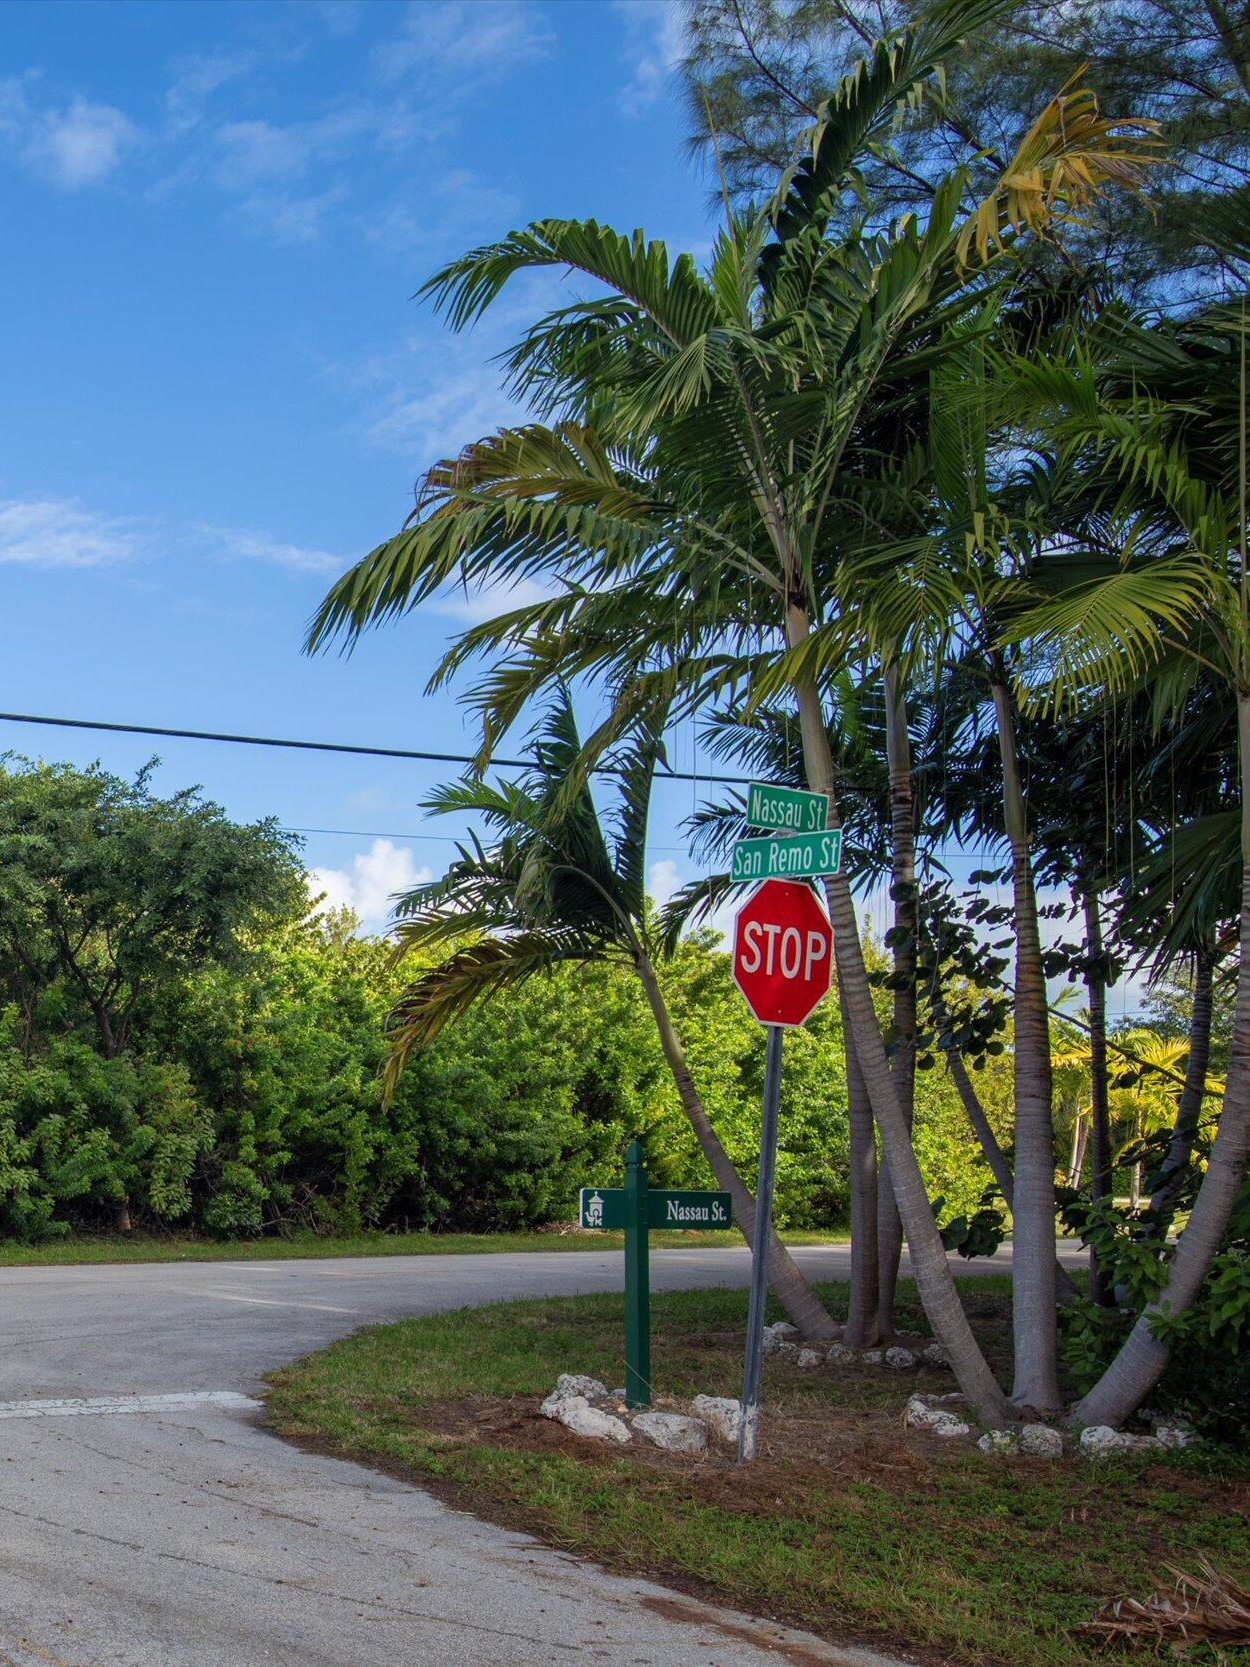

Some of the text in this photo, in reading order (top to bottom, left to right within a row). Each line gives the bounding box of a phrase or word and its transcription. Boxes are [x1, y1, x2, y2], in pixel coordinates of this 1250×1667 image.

[752, 789, 823, 831] Nassau St
[734, 837, 838, 876] San Remo St
[740, 920, 827, 981] STOP
[666, 1200, 727, 1221] Nassau St.
